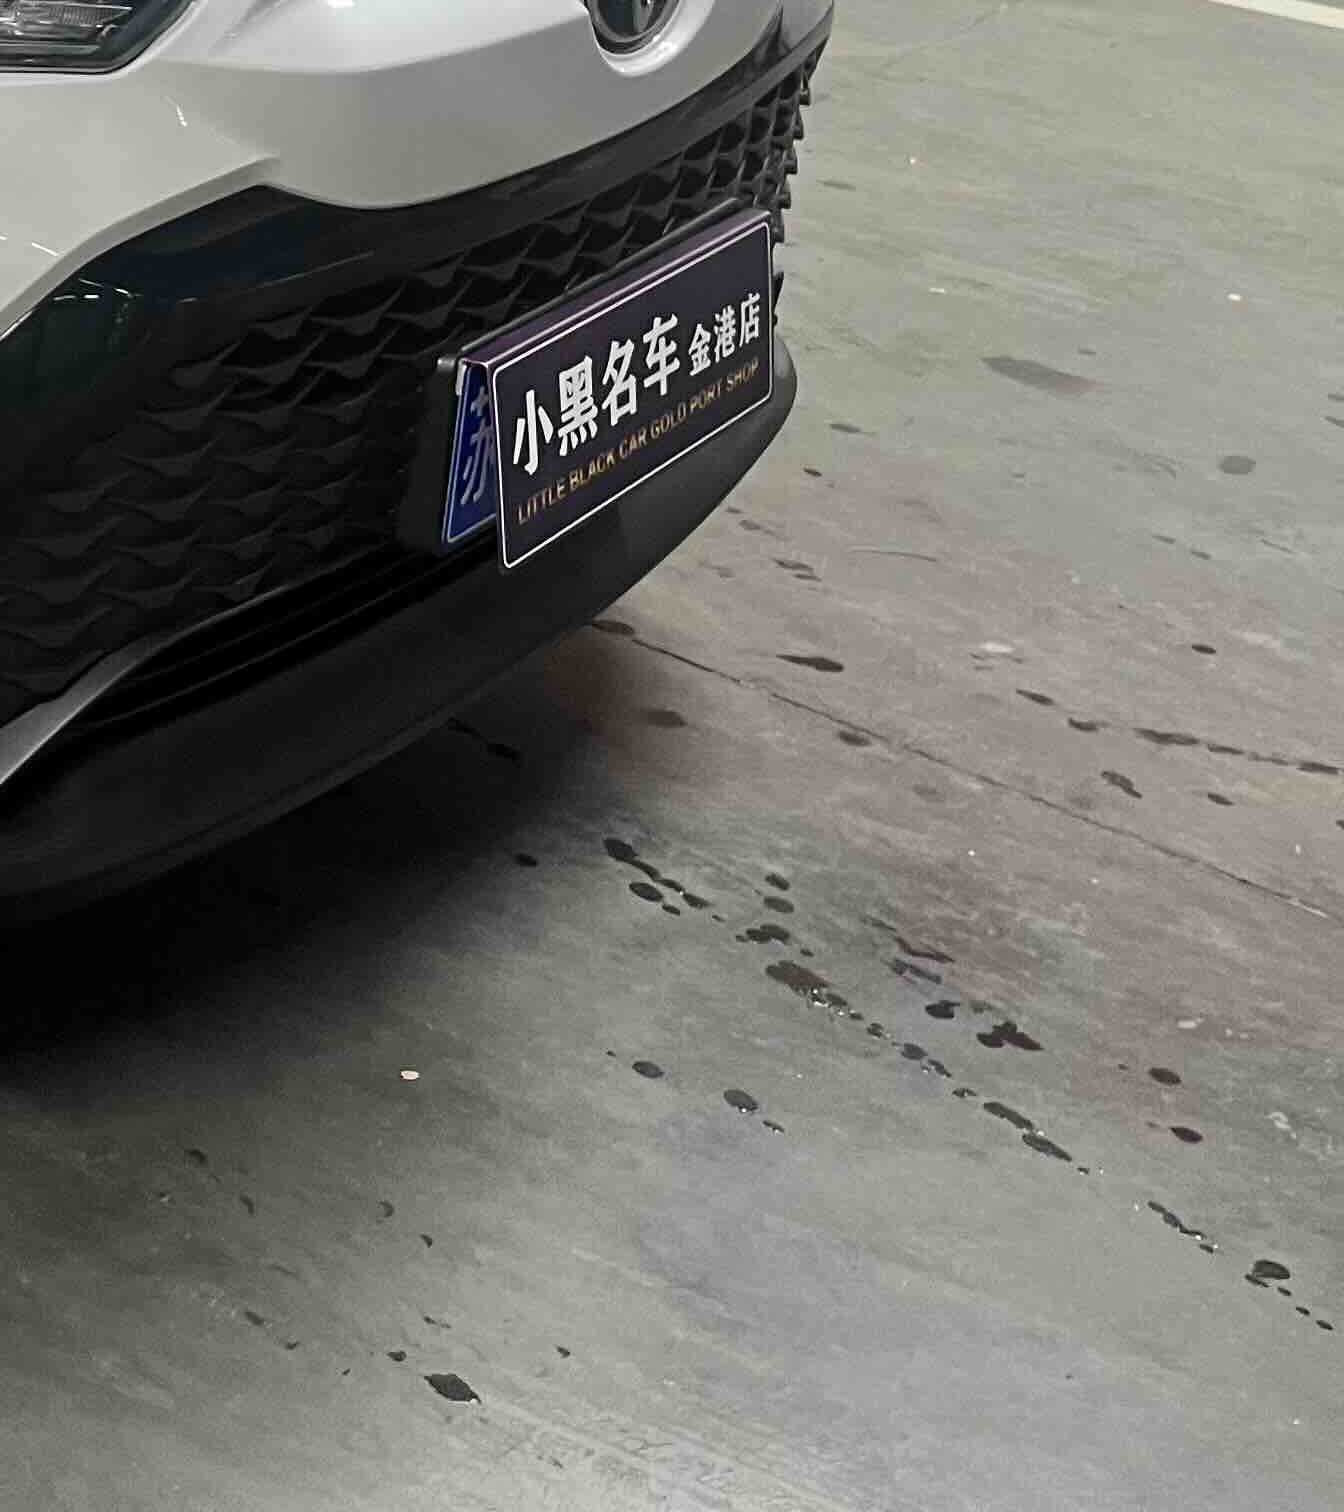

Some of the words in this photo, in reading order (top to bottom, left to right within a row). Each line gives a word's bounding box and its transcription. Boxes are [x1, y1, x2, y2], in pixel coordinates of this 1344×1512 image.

[512, 313, 681, 476] 小黑名车
[687, 291, 762, 378] 金港店
[518, 478, 566, 525] LITTLE
[568, 451, 616, 493] BLACK
[618, 429, 648, 459] CAR
[650, 402, 688, 439] GOLD
[688, 382, 722, 416] PORT
[724, 357, 761, 395] SHOP
